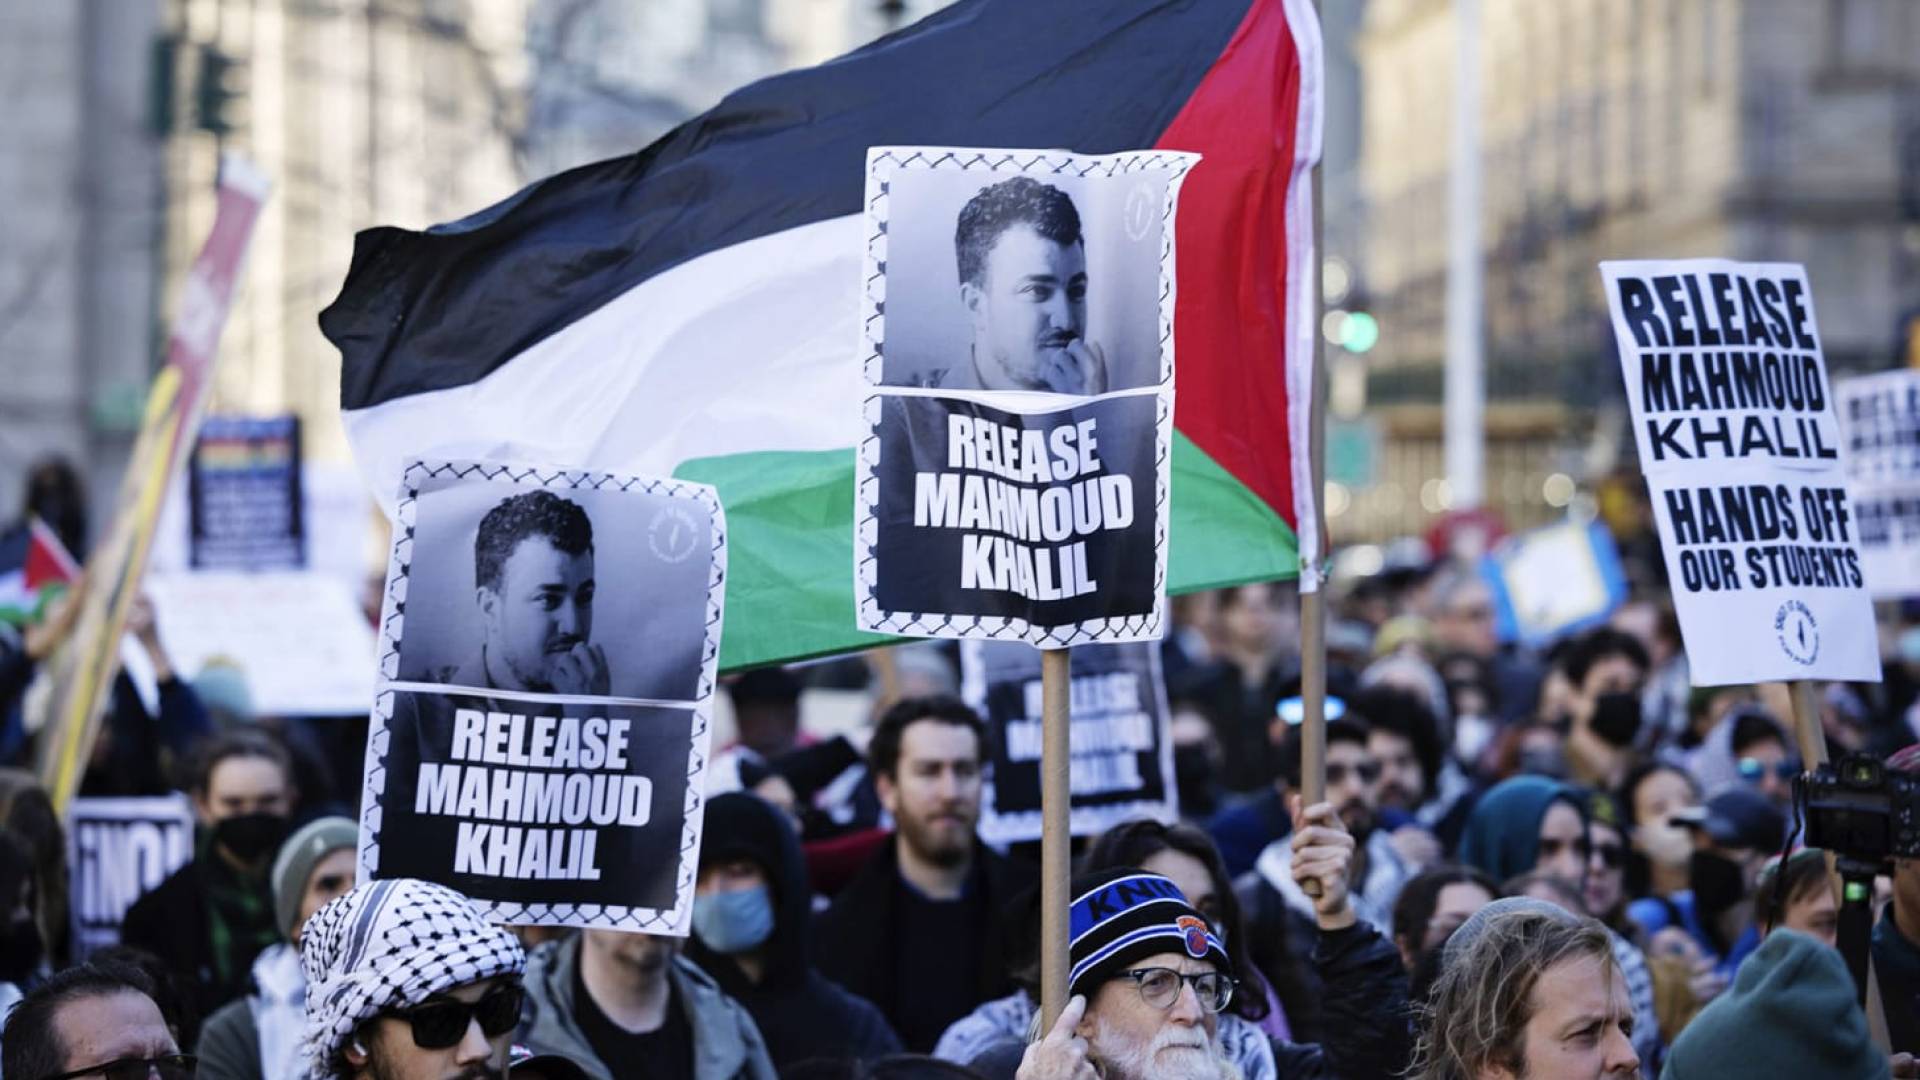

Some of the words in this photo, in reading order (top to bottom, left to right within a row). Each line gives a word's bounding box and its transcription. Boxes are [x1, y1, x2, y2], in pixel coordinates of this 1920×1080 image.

[1619, 274, 1815, 349] RELEASE
[1641, 353, 1825, 412] MAHMOUD
[948, 415, 1098, 482] RELEASE
[1648, 416, 1837, 460] KHALIL
[914, 473, 1133, 541] MAHMOUD
[1664, 486, 1798, 544] HANDS
[1801, 488, 1849, 542] OFF
[961, 535, 1097, 600] KHALIL
[1680, 549, 1740, 592] OUR
[1746, 546, 1863, 591] STUDENTS
[452, 709, 631, 768] RELEASE
[415, 763, 652, 826] MAHMOUD
[455, 823, 600, 880] KHALIL
